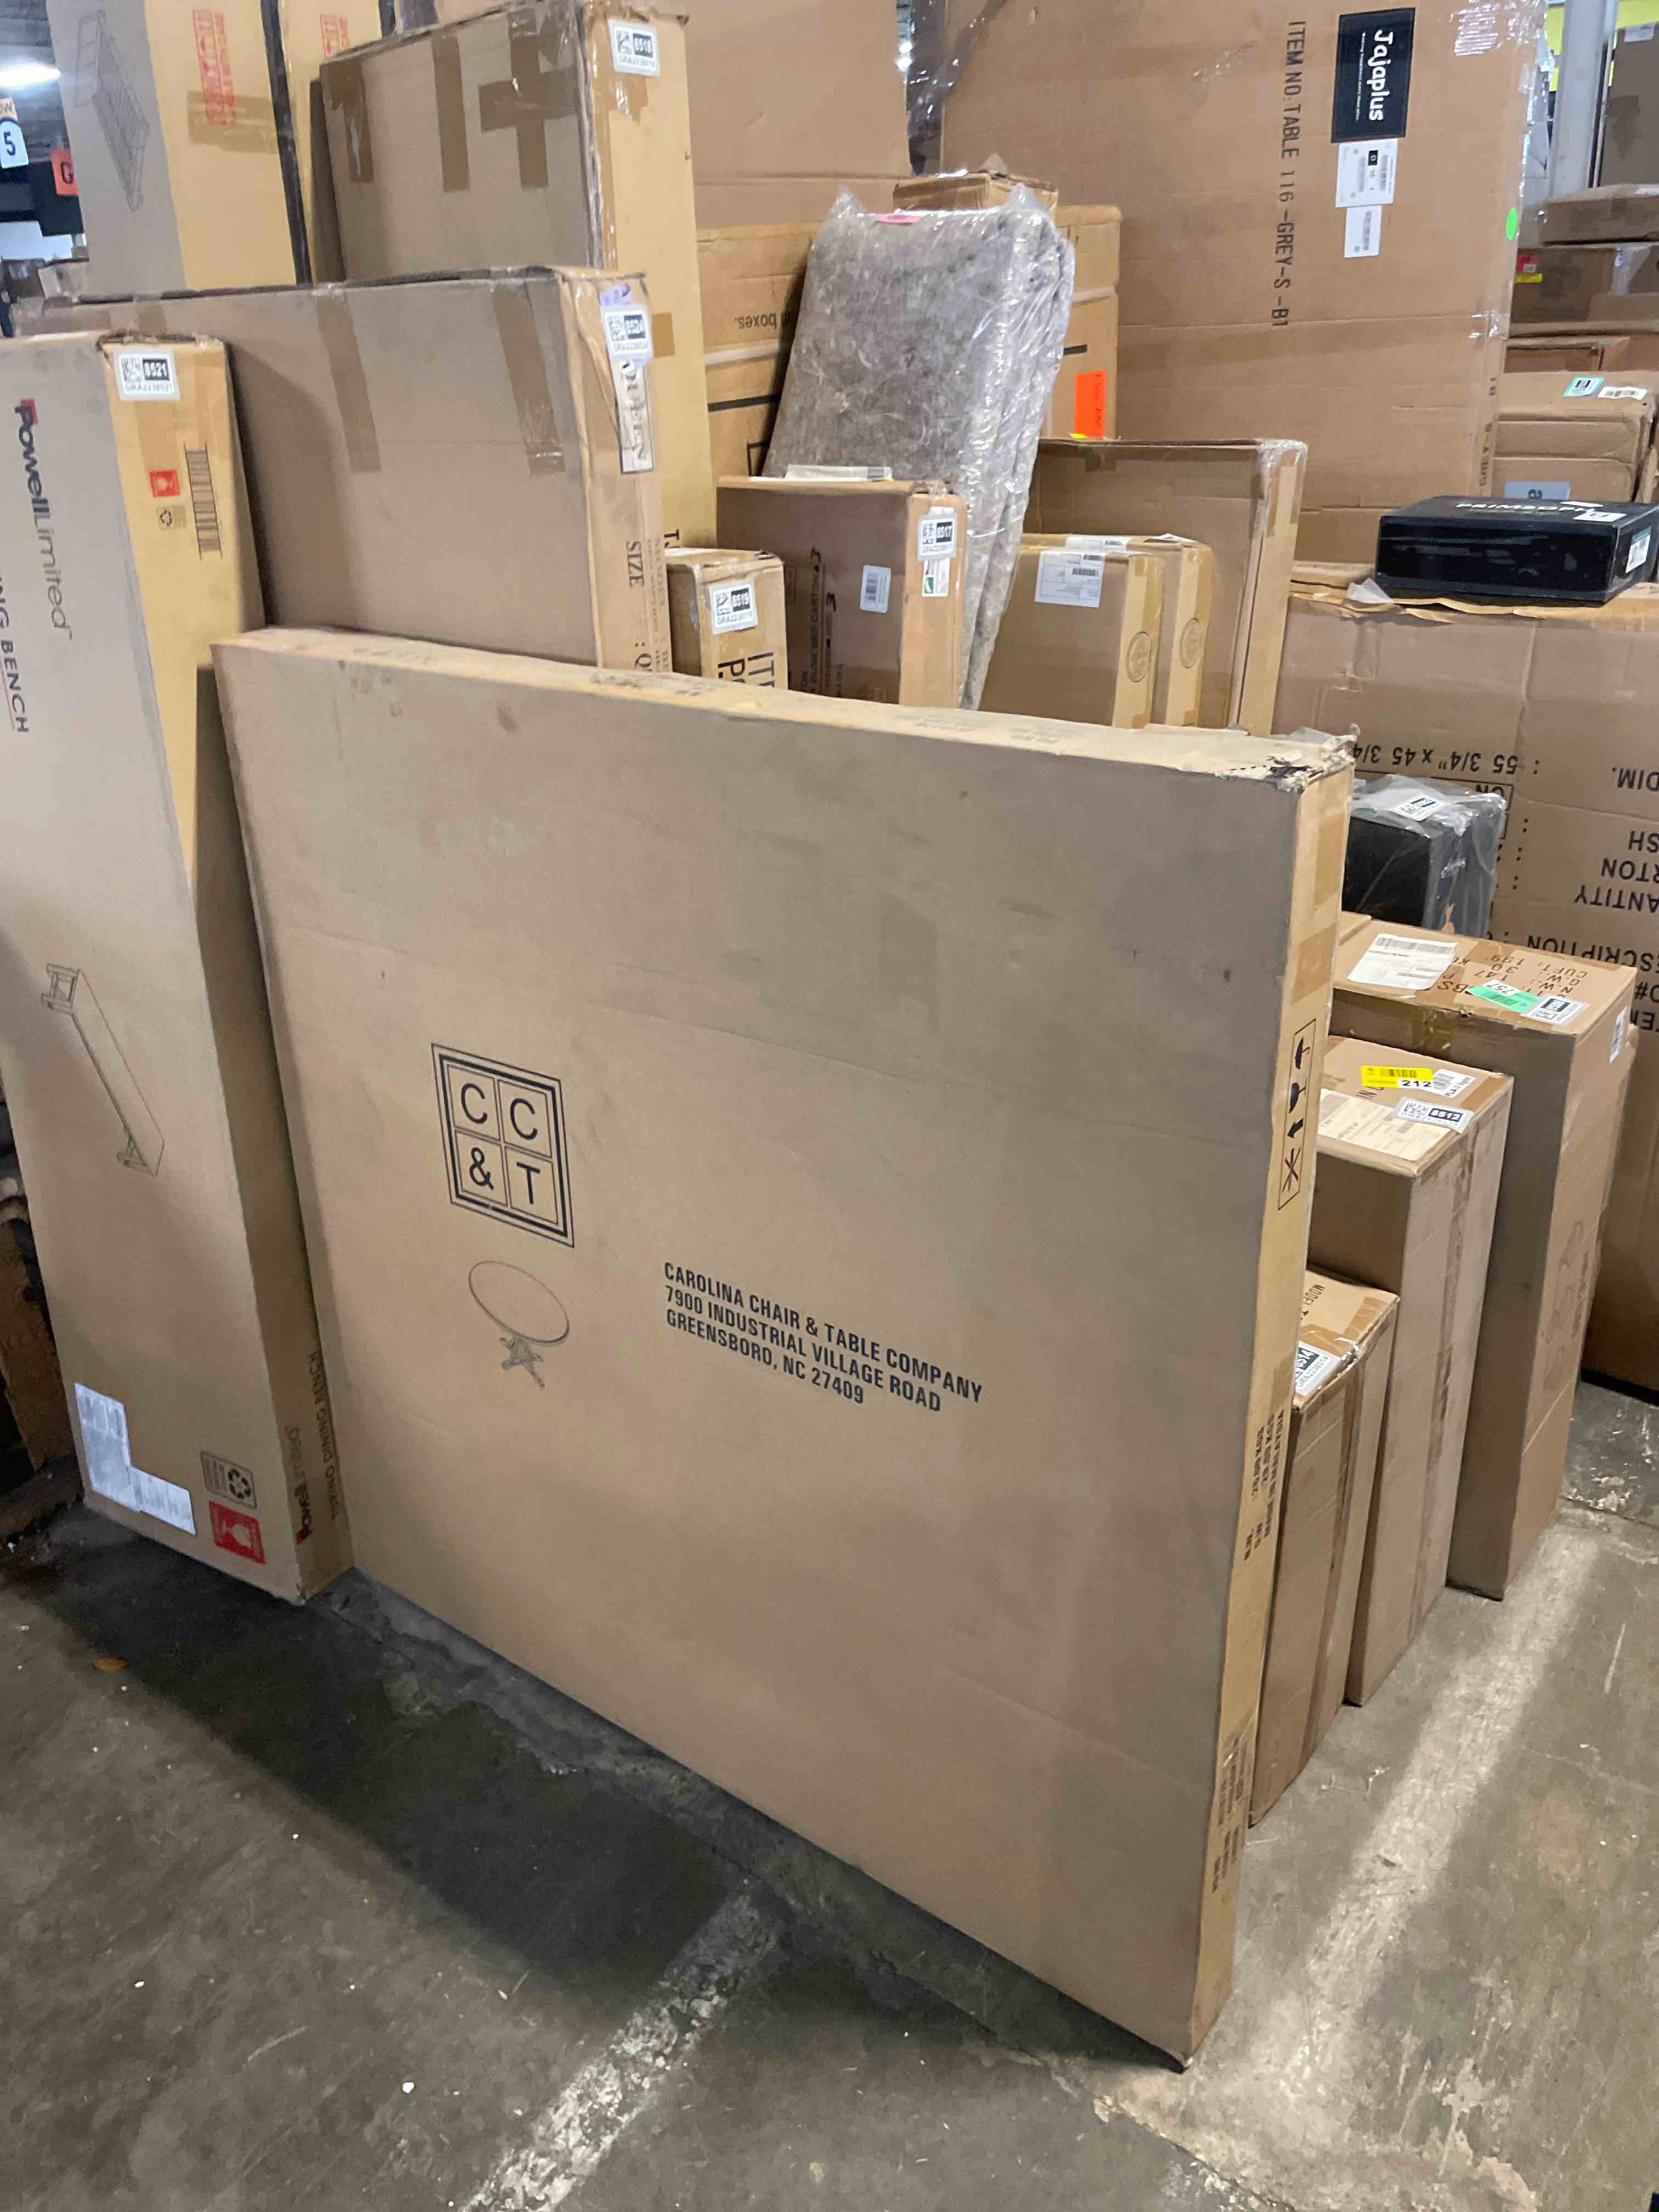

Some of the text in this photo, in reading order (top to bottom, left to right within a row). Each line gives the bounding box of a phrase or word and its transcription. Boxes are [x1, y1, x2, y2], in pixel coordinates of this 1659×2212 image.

[1286, 21, 1306, 65] ITEM
[1366, 29, 1394, 122] Jajaplus
[3, 131, 16, 156] 5
[1281, 104, 1301, 159] TABLE
[1278, 171, 1295, 202] 116
[626, 540, 645, 588] SIZE
[1, 640, 30, 733] BENCH
[1392, 747, 1416, 765] 45
[1493, 754, 1519, 775] 55
[460, 1082, 538, 1141] C C
[1401, 1080, 1432, 1088] 212
[469, 1147, 541, 1205] & T
[664, 1262, 982, 1403] CAROLINA CHAIR & TABLE COMPANY
[664, 1285, 941, 1413] 7900 INDUSTRIAL VILLAGE ROAD
[666, 1308, 865, 1404] GREENSBORO, NC 27409
